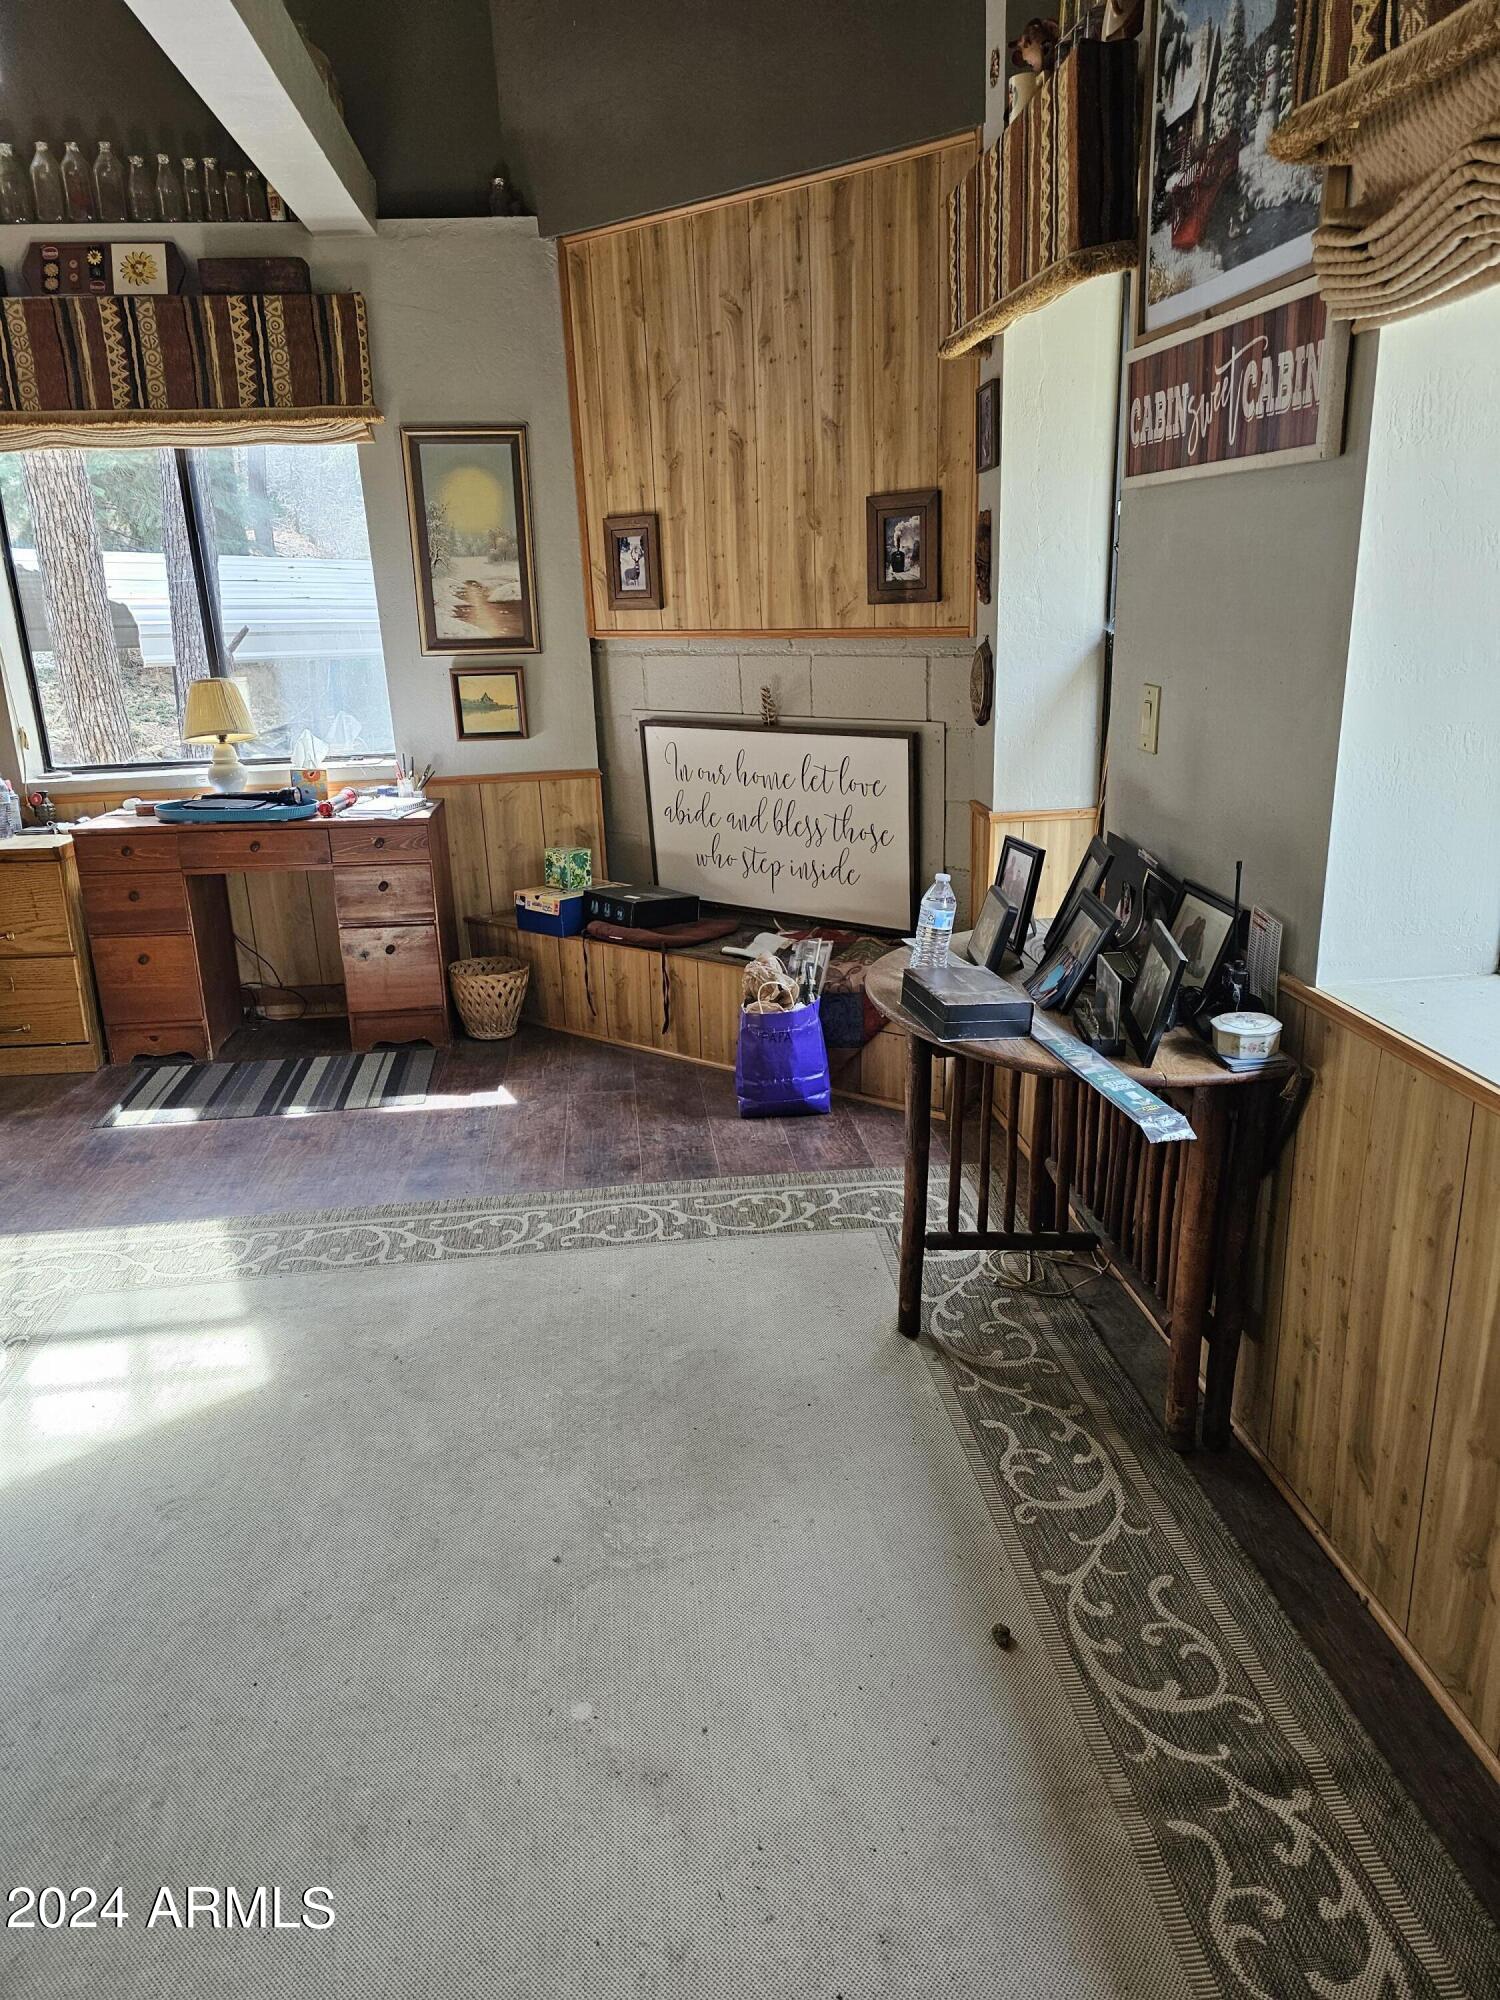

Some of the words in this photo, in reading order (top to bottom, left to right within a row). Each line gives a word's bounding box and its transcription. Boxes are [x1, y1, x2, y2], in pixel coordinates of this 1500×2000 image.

[1130, 383, 1189, 448] CABIN
[1243, 339, 1326, 422] CABIN
[664, 741, 693, 782] In
[697, 763, 732, 786] our
[736, 748, 796, 791] home
[801, 753, 838, 793] let
[838, 755, 887, 798] love
[664, 789, 722, 828] abide
[725, 796, 769, 833] and
[772, 798, 827, 848] bless
[823, 803, 894, 854] those
[695, 833, 738, 869] who
[740, 845, 786, 895] step
[789, 847, 860, 889] inside
